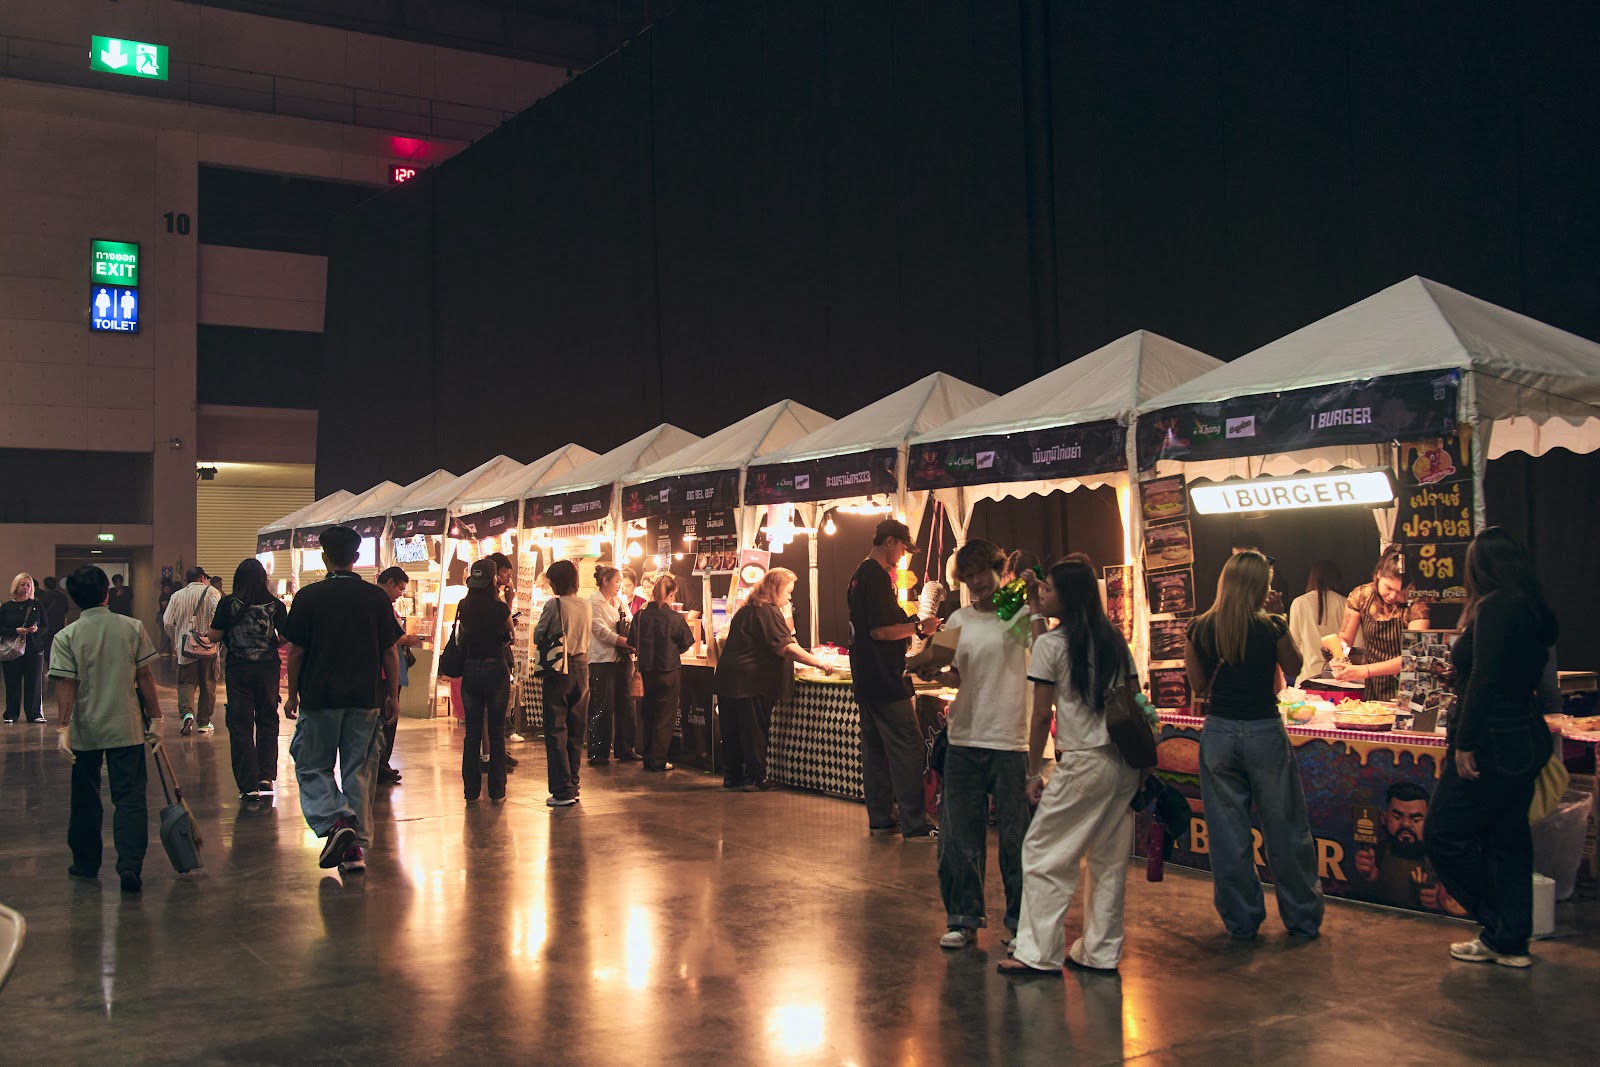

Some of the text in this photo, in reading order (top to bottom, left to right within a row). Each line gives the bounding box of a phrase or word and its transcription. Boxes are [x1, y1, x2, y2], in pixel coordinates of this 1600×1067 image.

[164, 212, 190, 235] 10
[96, 252, 135, 262] ทางออก
[96, 262, 135, 277] EXIT
[94, 319, 136, 331] TOILET
[1310, 407, 1372, 430] I BURGER
[1222, 482, 1355, 508] I BURGER
[1402, 507, 1471, 537] ฟรายส์
[1419, 544, 1454, 579] ชีส
